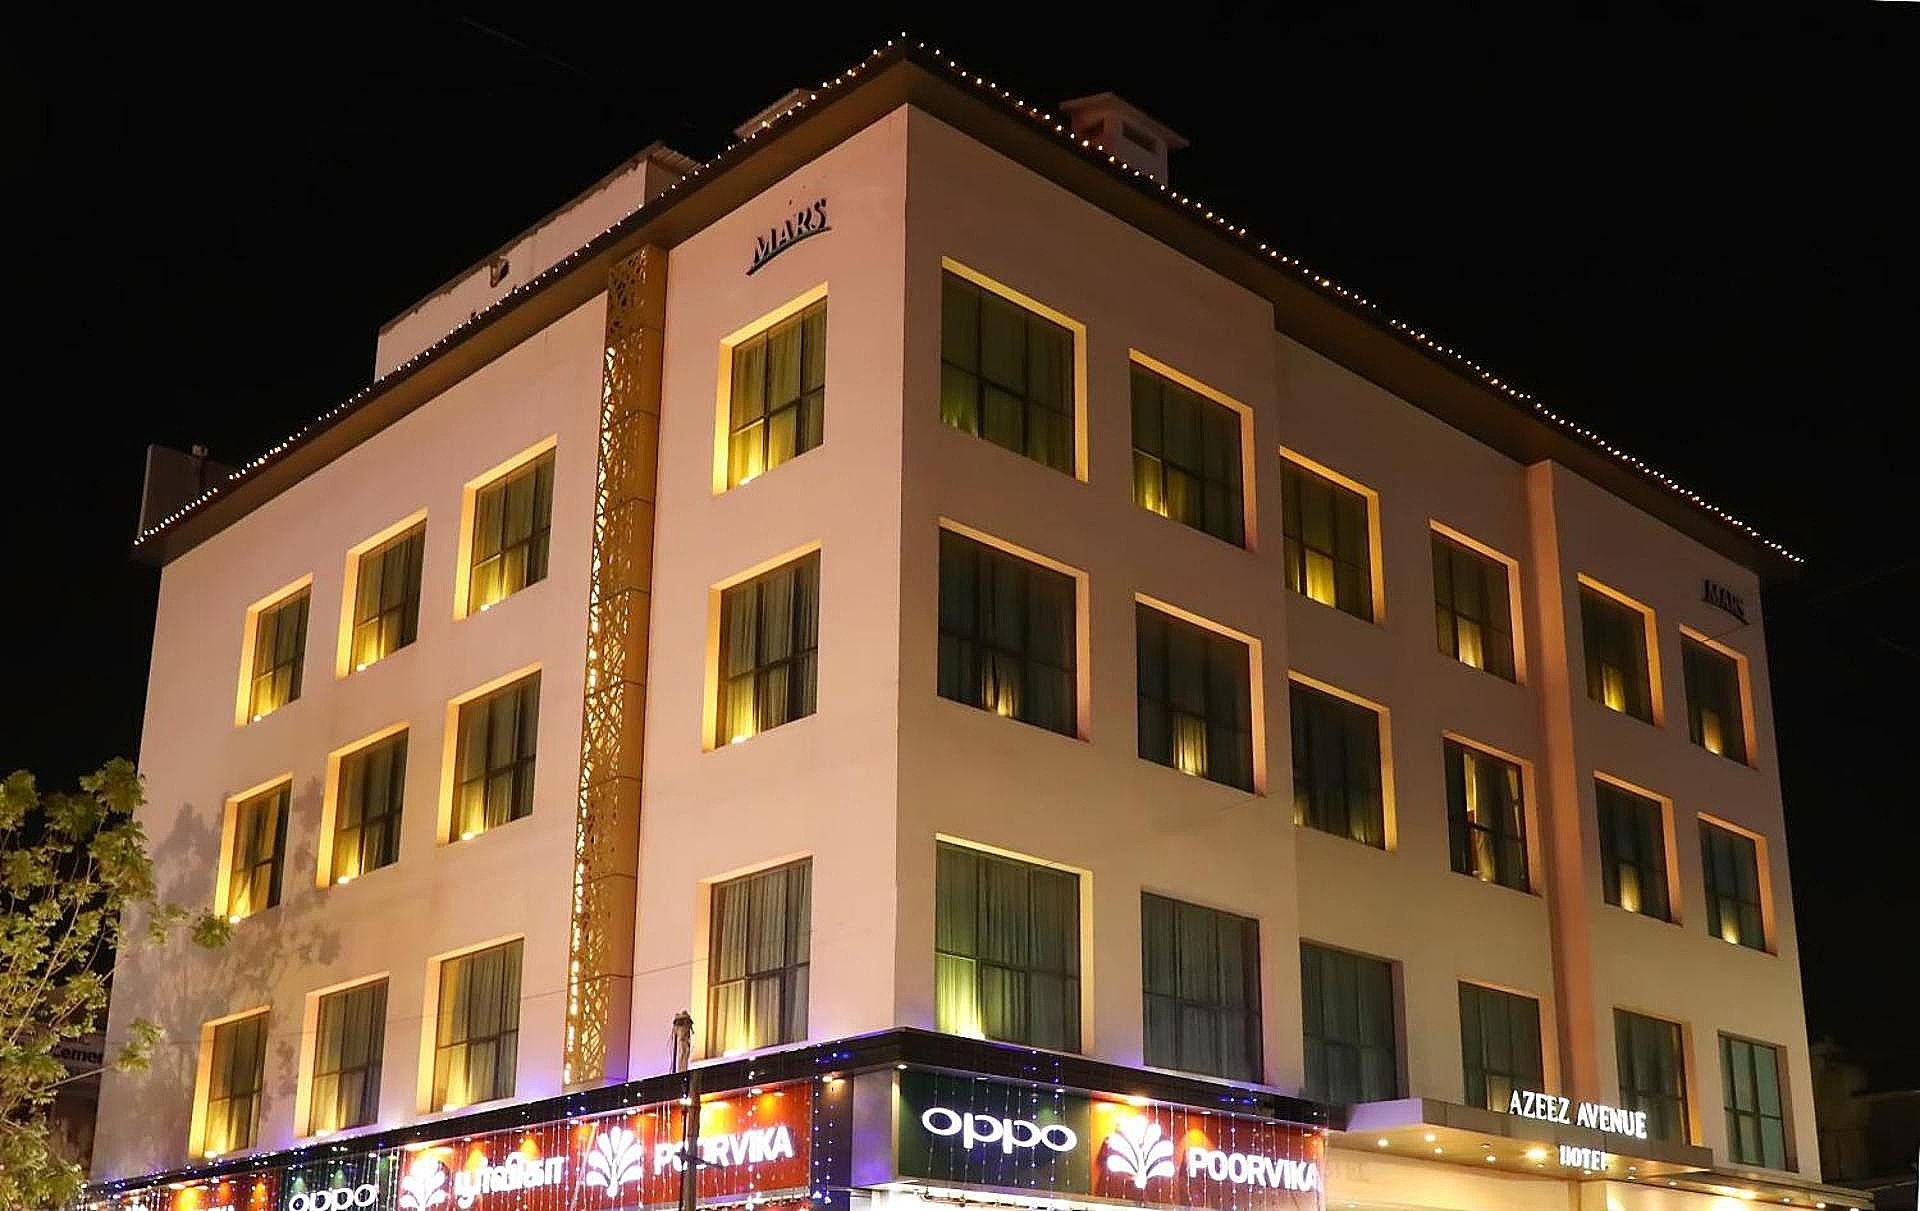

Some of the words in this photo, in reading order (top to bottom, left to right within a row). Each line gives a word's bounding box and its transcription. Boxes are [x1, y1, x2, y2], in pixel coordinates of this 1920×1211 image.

[750, 198, 828, 268] MARS
[1509, 1089, 1571, 1125] AZEEZ
[1576, 1102, 1648, 1139] AVENUE
[1188, 1147, 1322, 1192] POORVIKA
[1559, 1144, 1608, 1172] HOTEL
